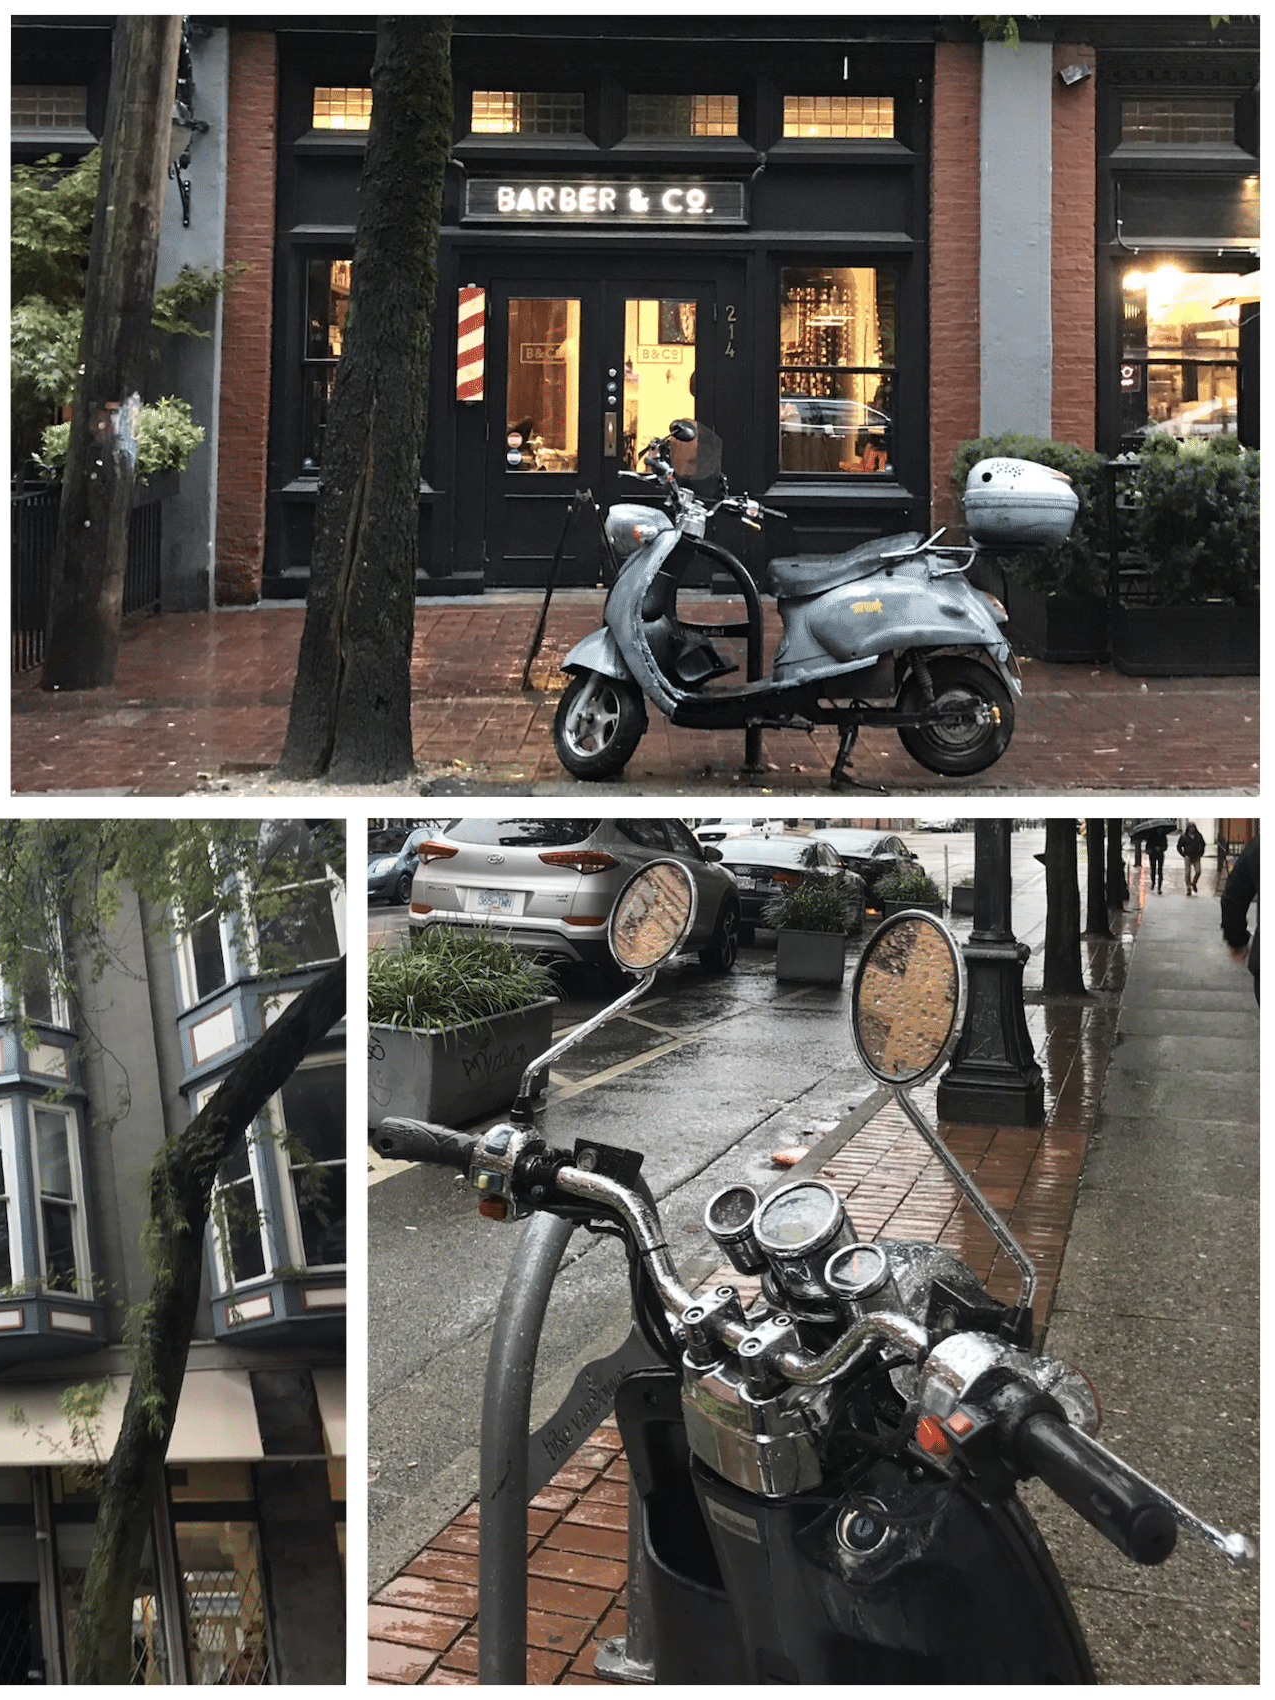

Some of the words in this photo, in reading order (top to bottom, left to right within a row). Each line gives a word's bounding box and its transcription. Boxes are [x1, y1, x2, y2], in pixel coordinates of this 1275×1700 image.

[497, 187, 616, 212] BARBER
[628, 187, 650, 212] &
[724, 304, 737, 358] 214
